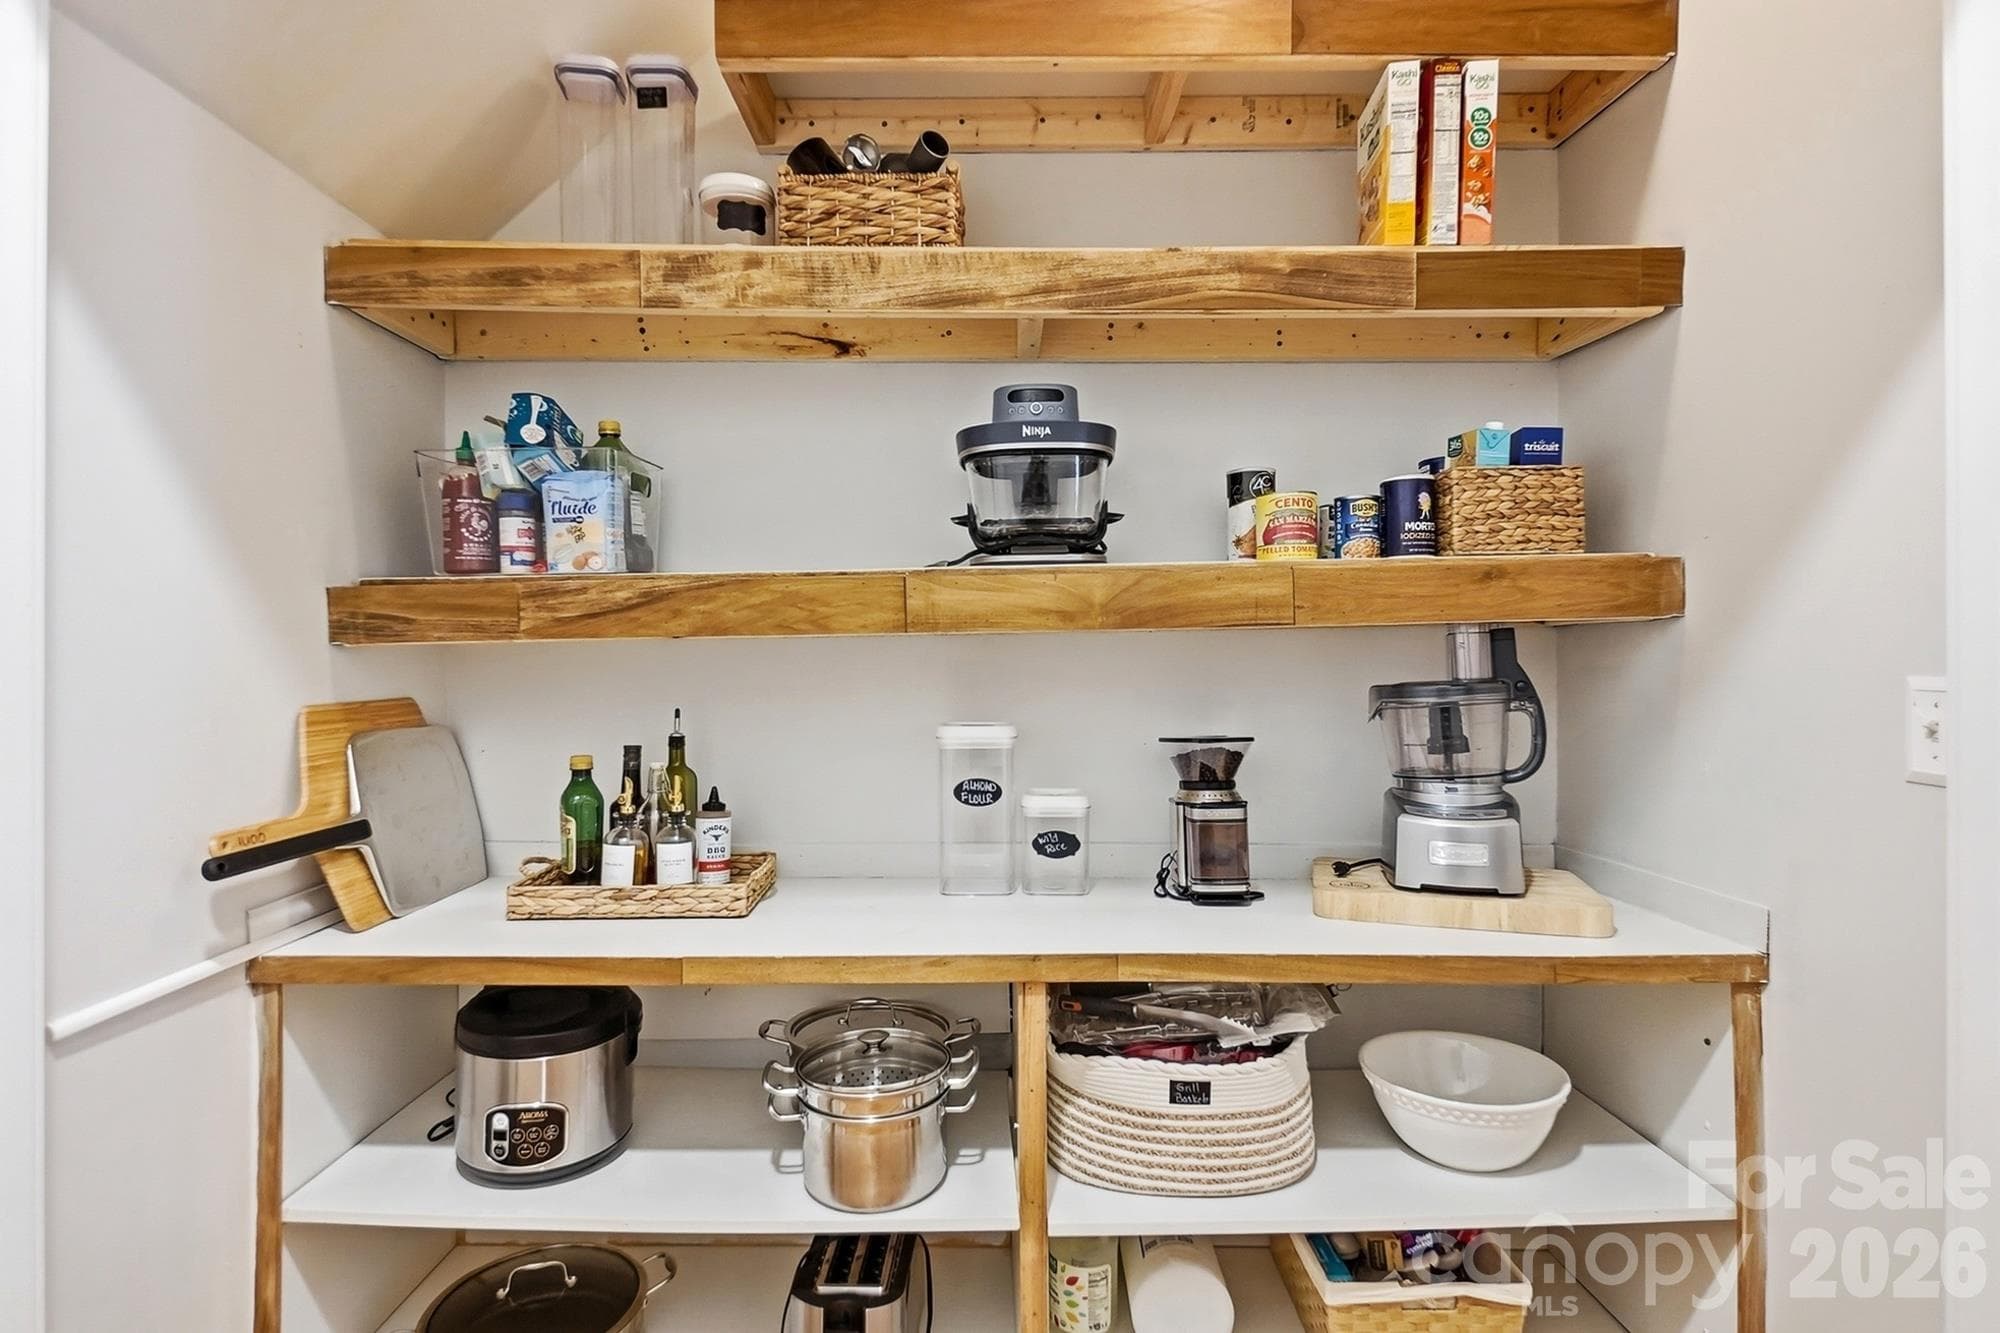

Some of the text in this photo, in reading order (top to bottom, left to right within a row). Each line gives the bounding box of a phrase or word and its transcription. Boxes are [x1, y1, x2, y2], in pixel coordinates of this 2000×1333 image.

[1391, 69, 1418, 80] Kashi
[1469, 73, 1495, 82] Kashi
[1022, 424, 1052, 438] NINJA
[1524, 440, 1560, 452] triscuit
[1252, 475, 1272, 495] 4C
[552, 500, 597, 515] fluide
[1275, 498, 1313, 509] CENTO
[962, 780, 997, 792] ALMOND
[961, 792, 993, 804] FLOUR
[1175, 1082, 1200, 1093] Grill
